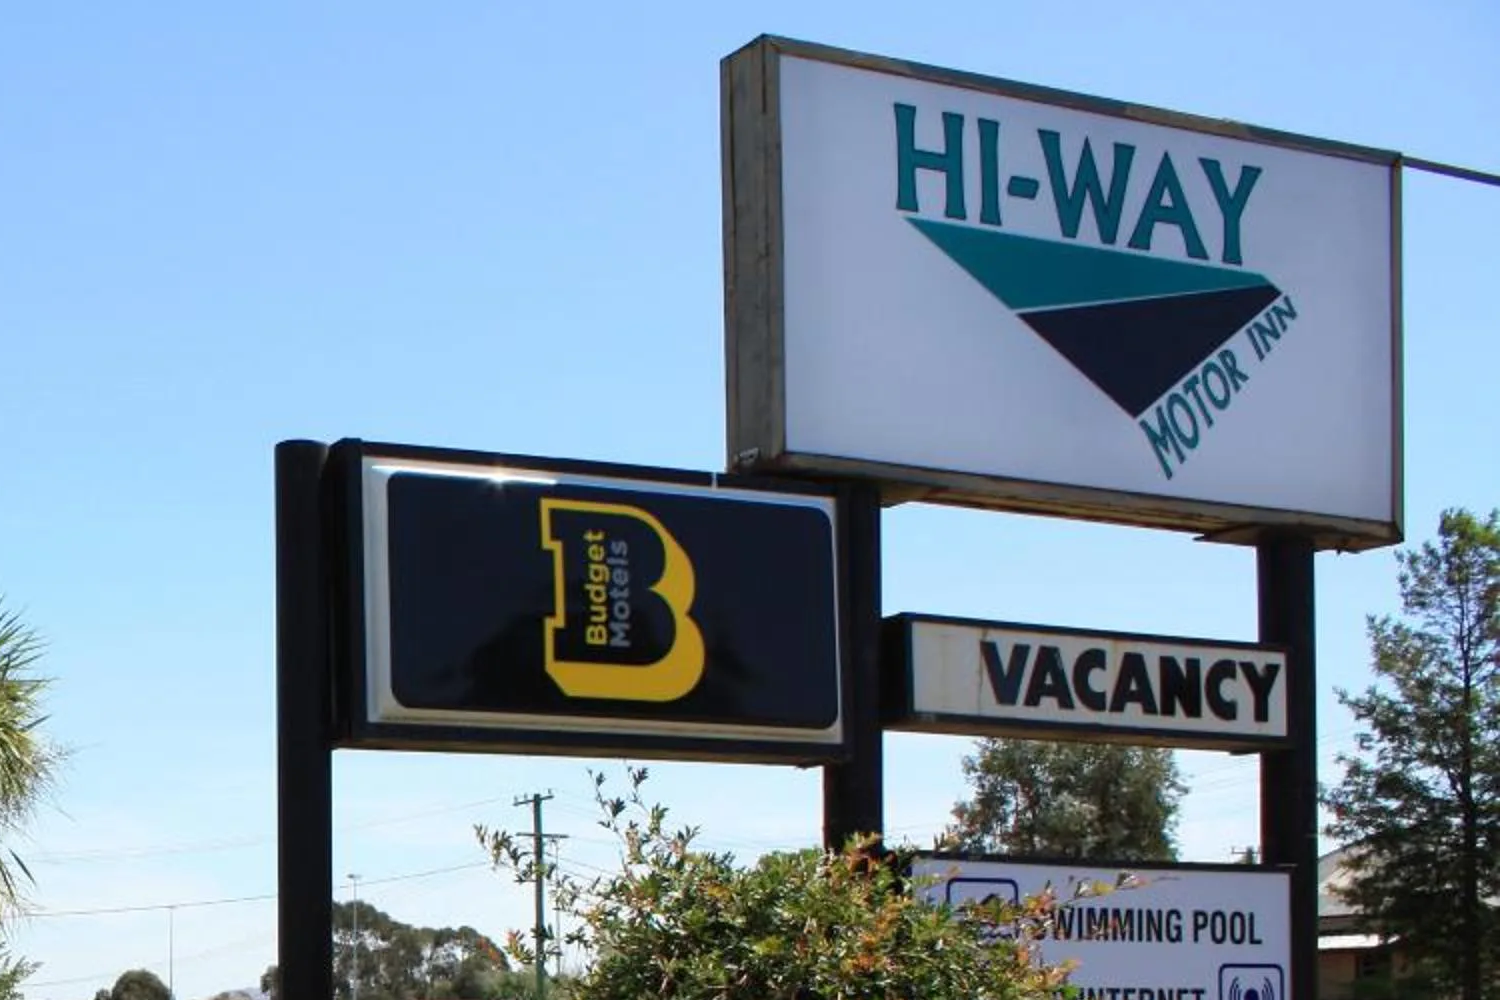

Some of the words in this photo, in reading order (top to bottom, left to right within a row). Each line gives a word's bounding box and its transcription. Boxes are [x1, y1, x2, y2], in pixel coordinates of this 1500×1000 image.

[894, 103, 1263, 266] HI-WAY
[1138, 349, 1250, 481] MOTOR
[1246, 295, 1298, 361] INN
[583, 529, 610, 645] Budget
[606, 540, 631, 648] Motels
[980, 640, 1281, 723] VACANCY
[1033, 905, 1182, 943] WIMMING
[1193, 911, 1263, 946] POOL
